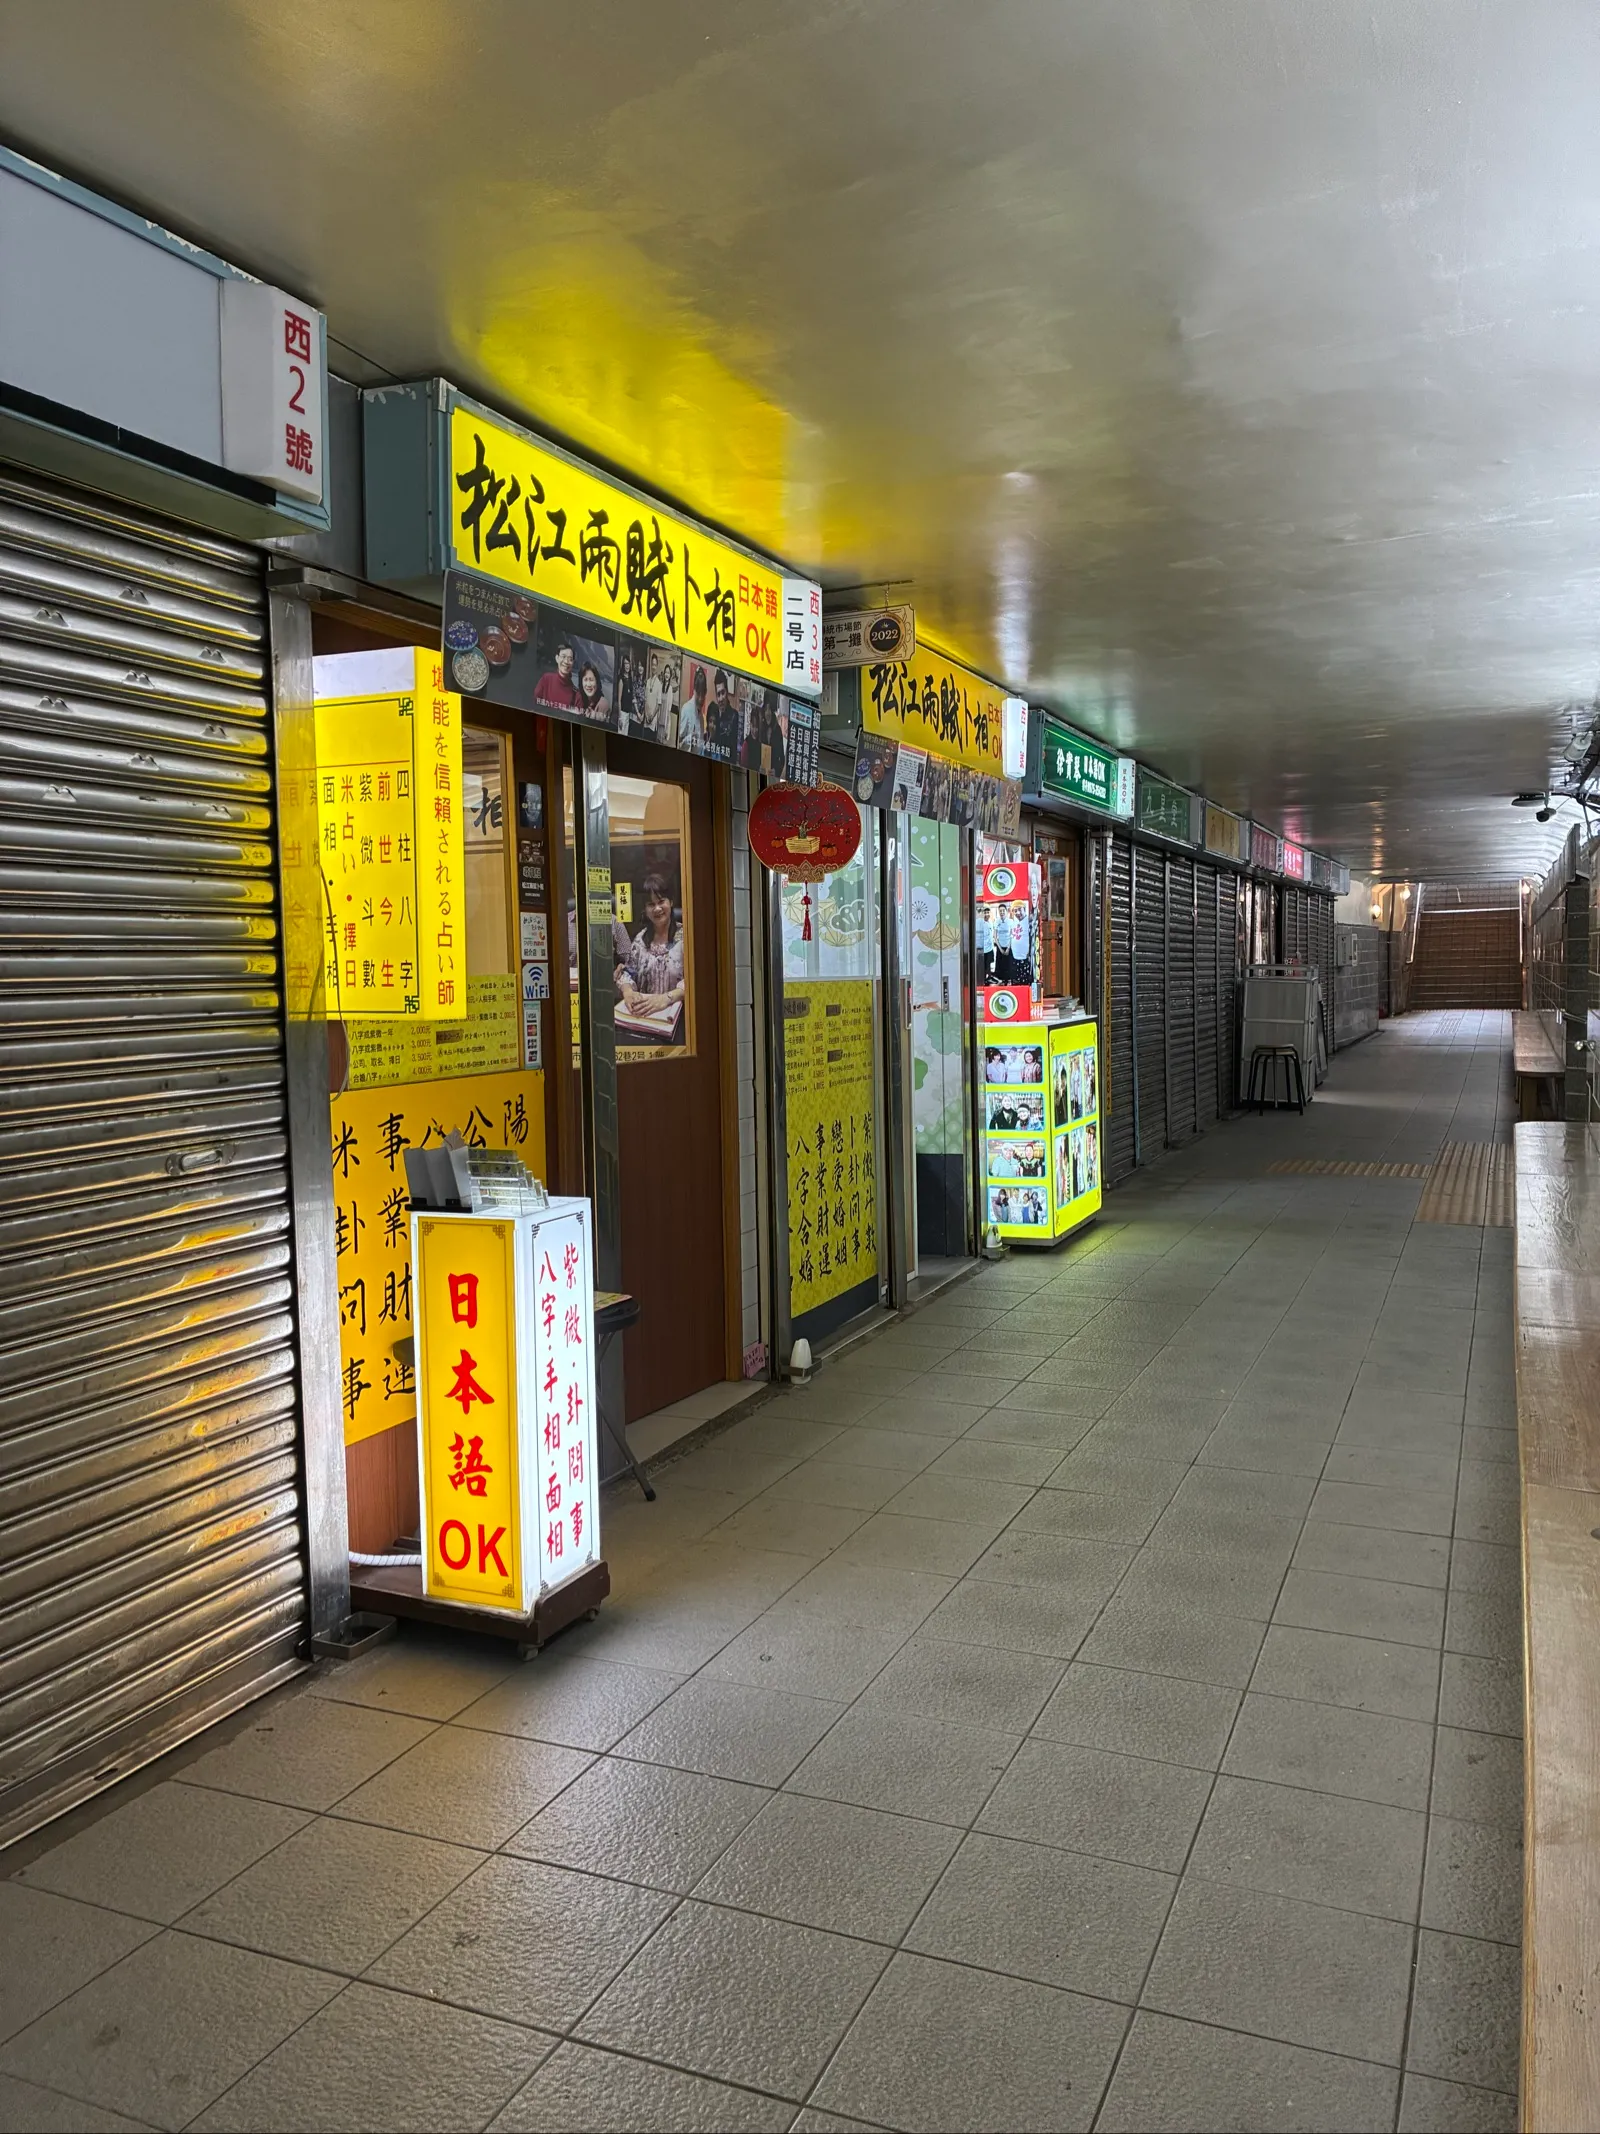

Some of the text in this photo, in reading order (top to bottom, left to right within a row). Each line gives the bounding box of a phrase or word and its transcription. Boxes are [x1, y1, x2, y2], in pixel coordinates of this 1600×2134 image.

[284, 309, 313, 475] 西2號
[738, 573, 778, 620] 日本語
[745, 621, 771, 665] OK
[786, 596, 804, 671] 二号店
[809, 590, 820, 684] 西3號
[822, 620, 862, 634] 統市場節
[823, 632, 862, 650] 第一攤
[871, 629, 899, 642] 2022
[987, 702, 1003, 728] 日本
[359, 772, 376, 988] 紫微斗數
[377, 773, 394, 988] 前世今生
[396, 769, 413, 988] 四柱八字
[525, 983, 548, 998] WiFi
[503, 1094, 529, 1146] 陽
[444, 1272, 495, 1498] 日本語
[438, 1518, 510, 1577] OK
